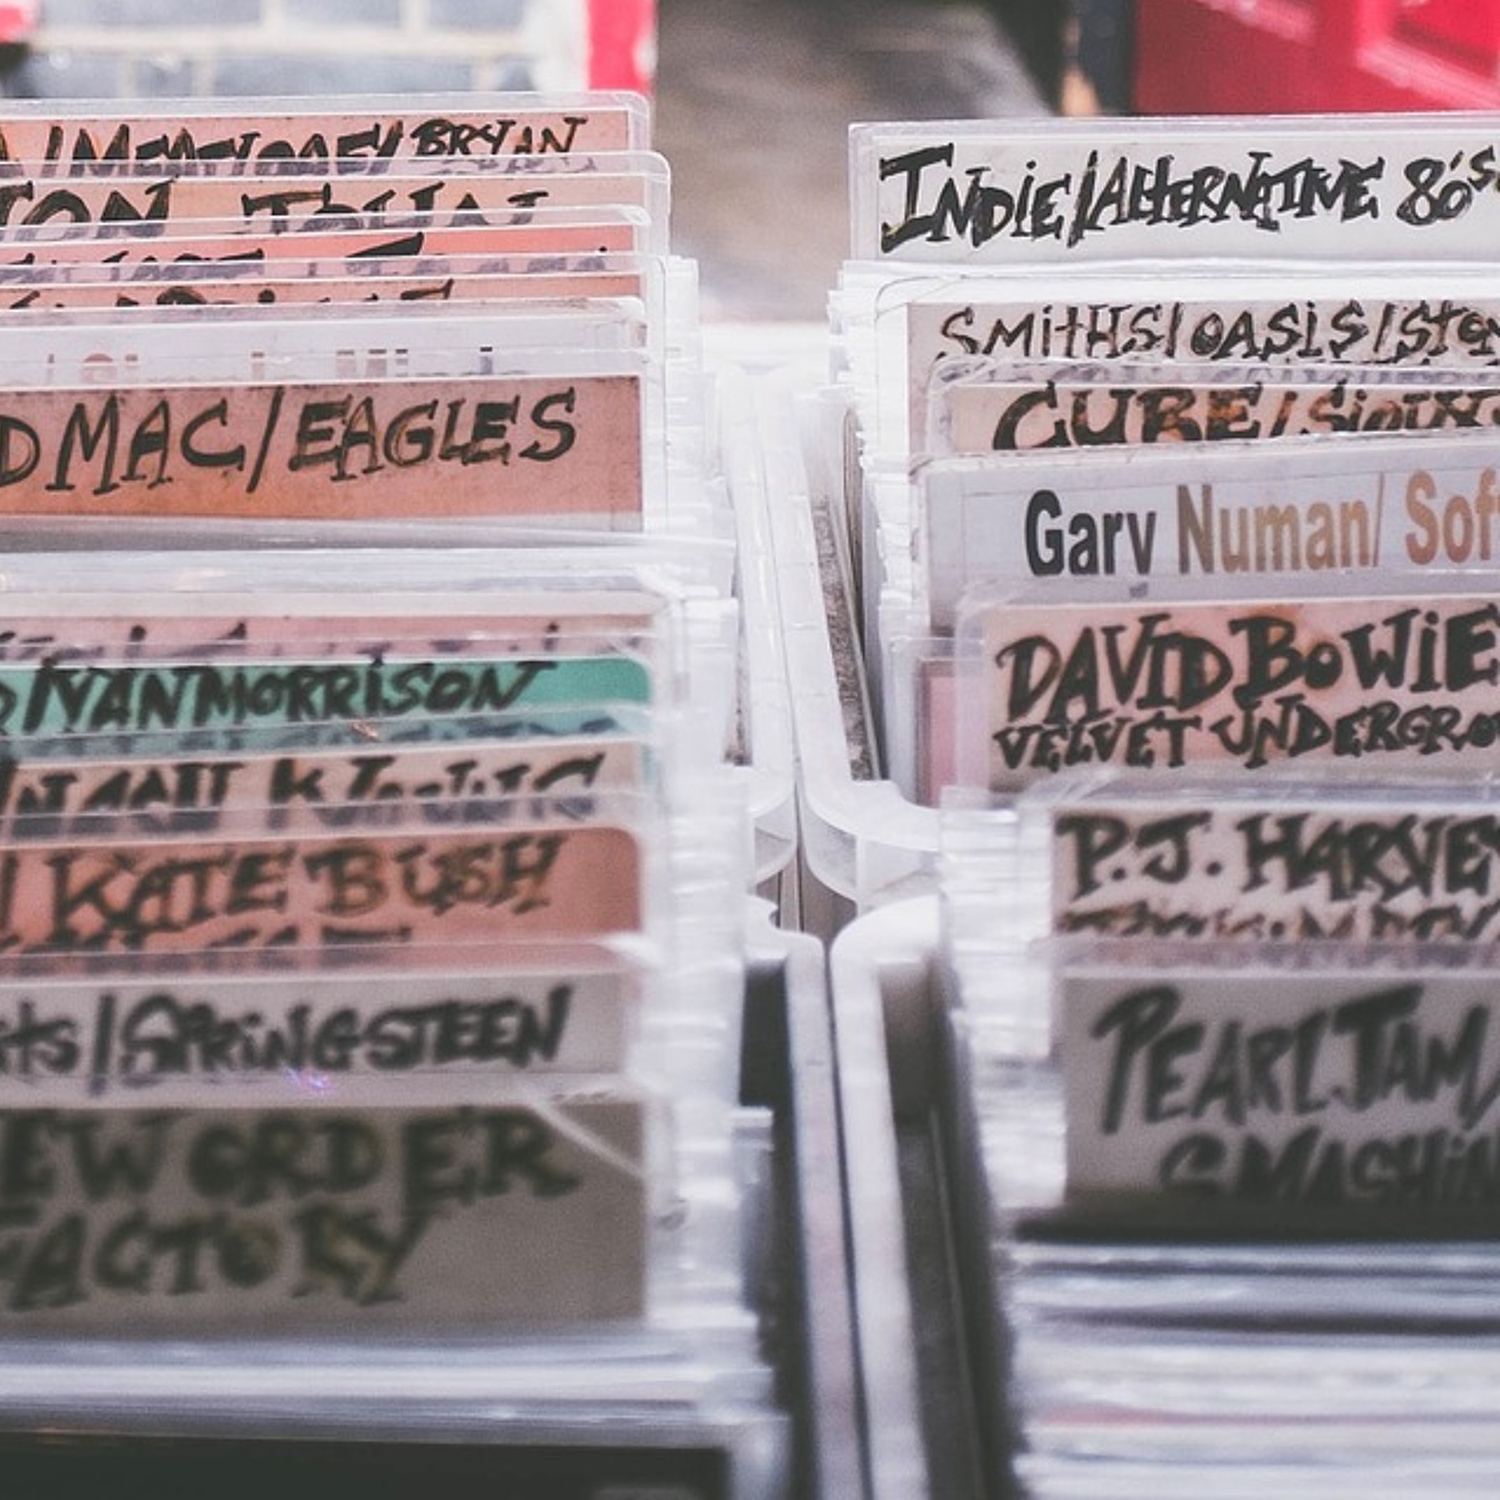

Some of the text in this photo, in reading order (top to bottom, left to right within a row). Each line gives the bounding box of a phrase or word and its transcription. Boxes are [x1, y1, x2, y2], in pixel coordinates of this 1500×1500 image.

[1405, 466, 1500, 566] Sof
[996, 613, 1233, 726] DAVID
[994, 695, 1500, 772] VELVET UNDERGRO
[303, 834, 568, 916] BUSH
[1237, 811, 1500, 902] HARVE
[1090, 984, 1329, 1136] PEARL
[190, 1106, 579, 1205] ORDER
